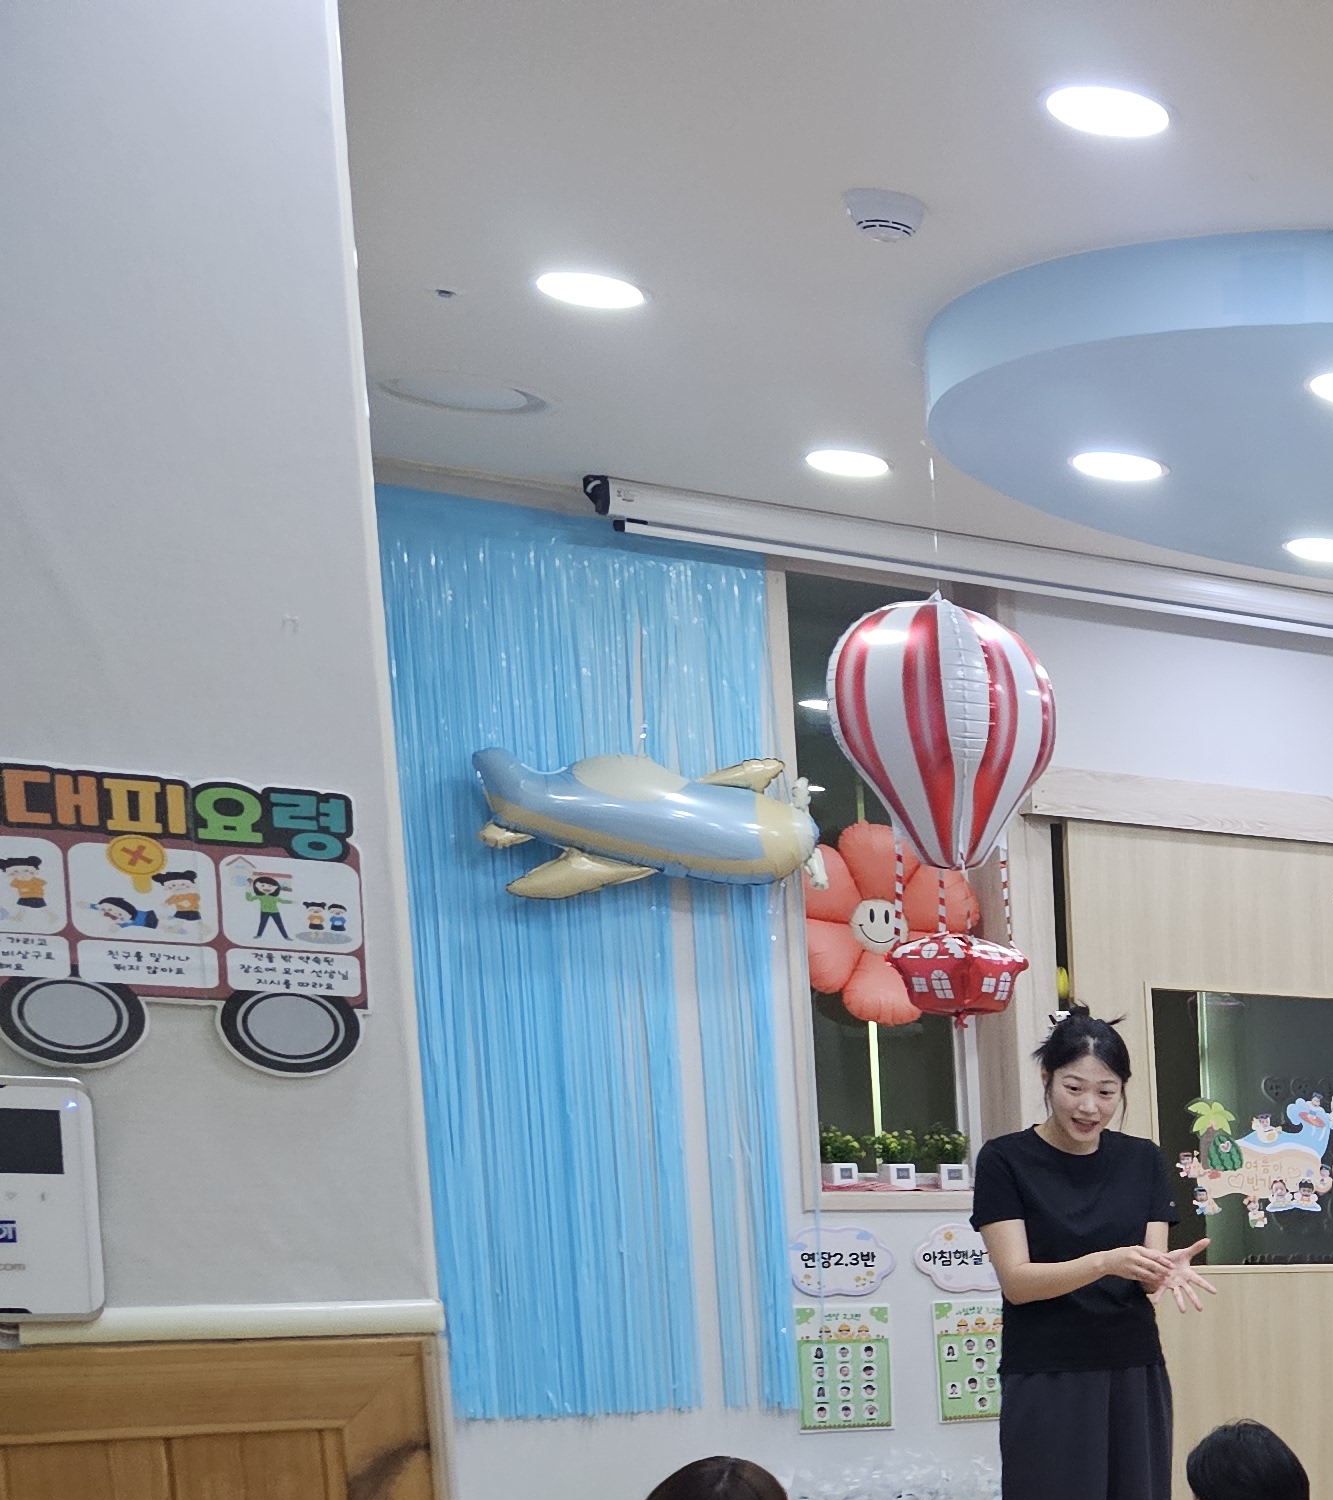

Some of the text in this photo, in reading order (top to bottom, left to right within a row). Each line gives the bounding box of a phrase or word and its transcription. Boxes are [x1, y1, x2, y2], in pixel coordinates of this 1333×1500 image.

[2, 768, 347, 861] 대피요령
[107, 949, 190, 962] 친구를 밀거나
